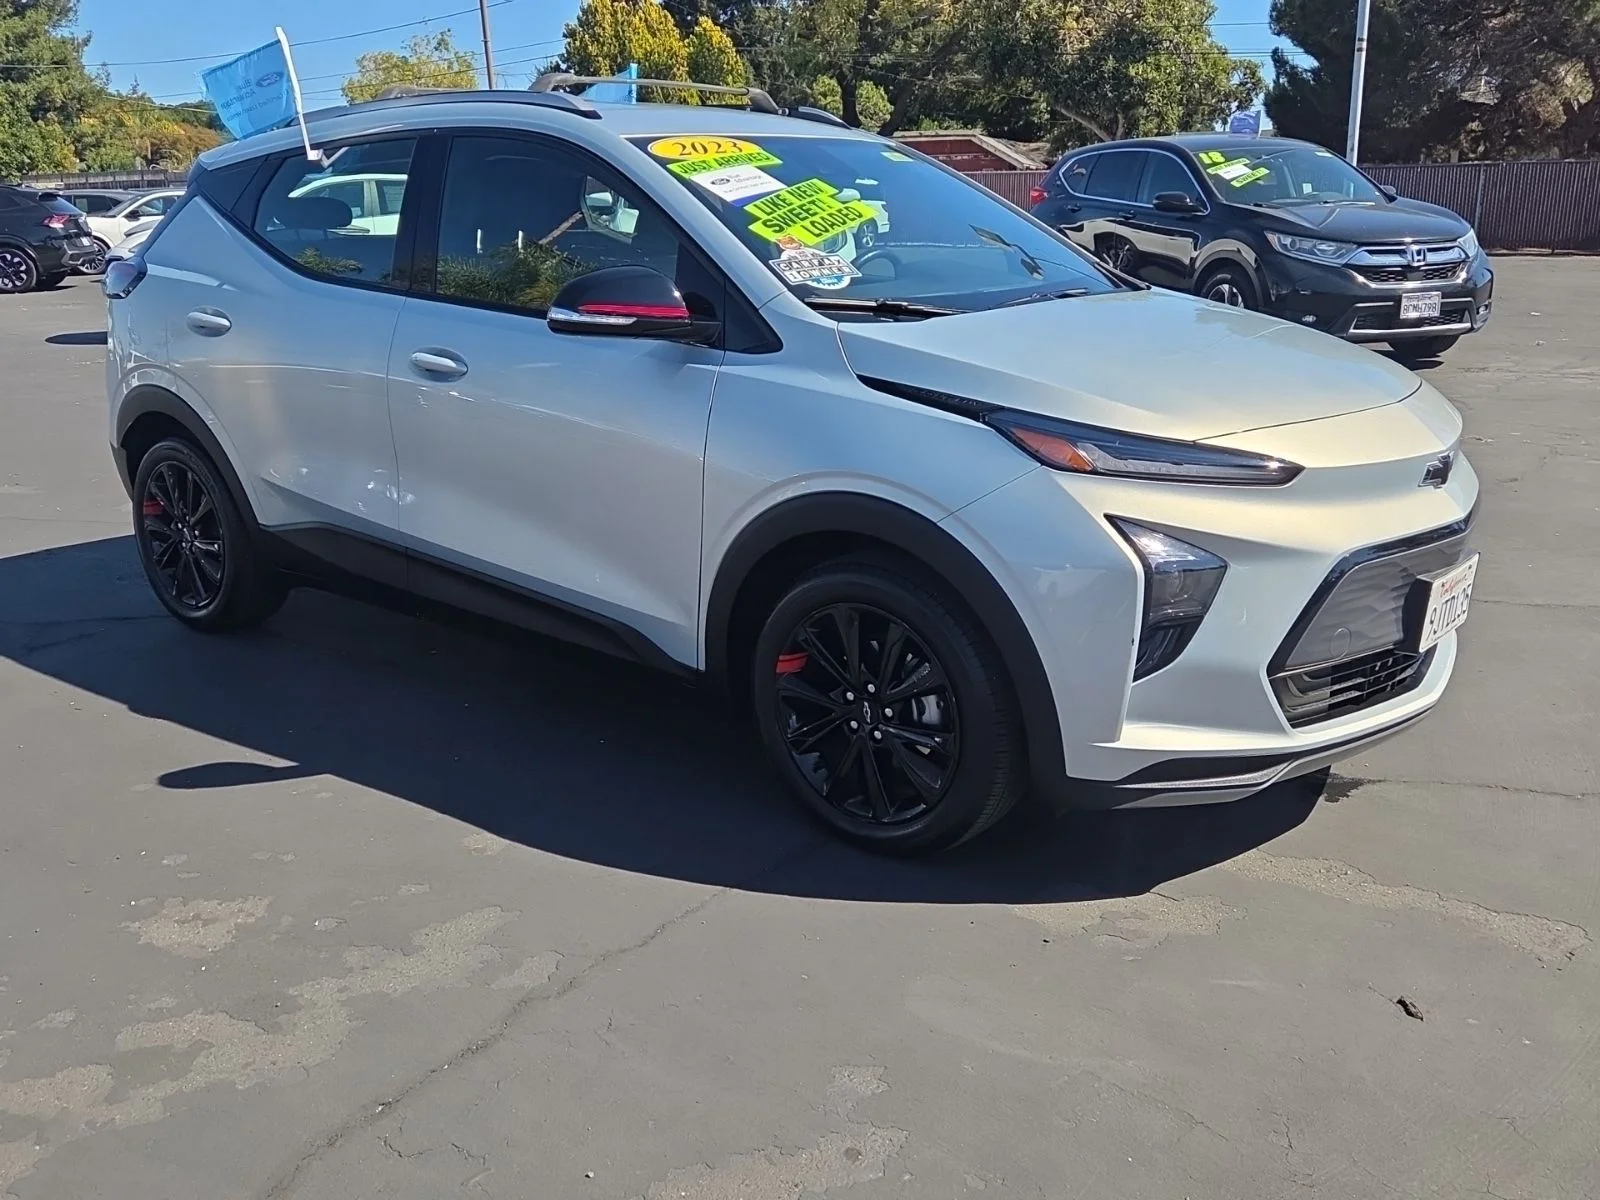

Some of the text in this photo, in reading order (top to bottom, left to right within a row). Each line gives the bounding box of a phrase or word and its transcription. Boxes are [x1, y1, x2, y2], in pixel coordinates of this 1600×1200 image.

[672, 141, 743, 156] 2023
[1199, 151, 1226, 164] 18
[677, 152, 771, 174] JUST ARRIVED
[753, 194, 793, 216] LIKE
[788, 181, 825, 201] NEW
[762, 198, 834, 233] SWEET!
[800, 205, 863, 238] LOADED
[777, 256, 842, 272] CARFAX
[799, 265, 853, 281] OWNER
